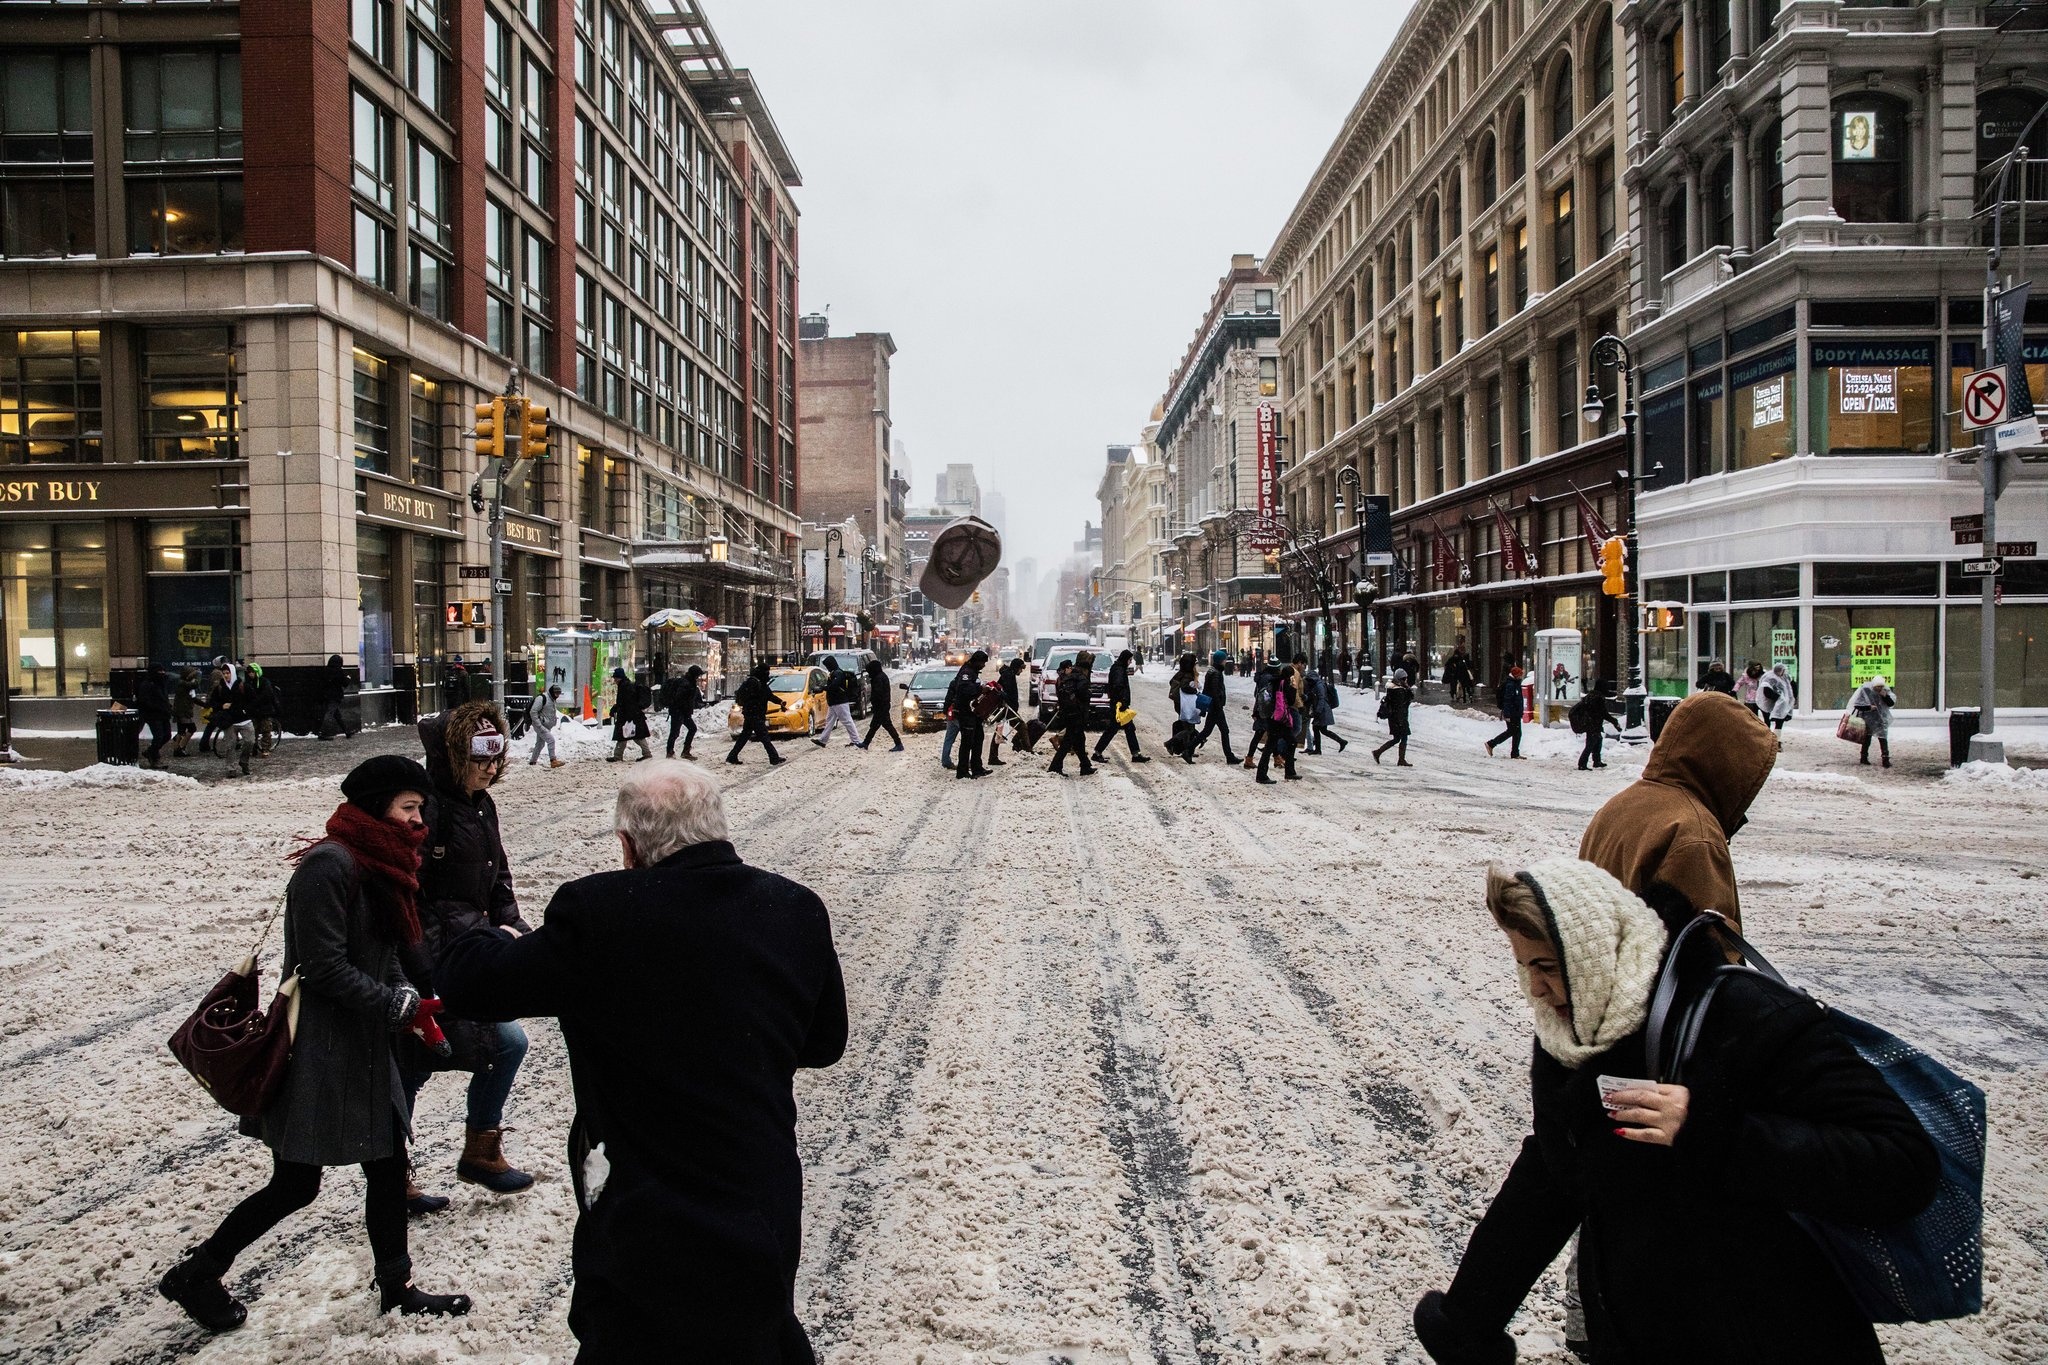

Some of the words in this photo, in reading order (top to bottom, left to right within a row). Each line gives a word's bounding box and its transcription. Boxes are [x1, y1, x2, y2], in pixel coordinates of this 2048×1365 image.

[1815, 348, 1856, 361] BODY
[1861, 348, 1929, 361] MASSAGE
[1845, 373, 1872, 384] CHELSEA
[1873, 373, 1892, 384] NAILS
[1845, 384, 1892, 394] 212-924-6245
[1843, 397, 1865, 410] OPEN
[1866, 393, 1874, 412] 7
[1874, 397, 1895, 410] DAYS
[1260, 407, 1273, 528] Burlington
[48, 481, 101, 501] BUY
[383, 492, 411, 515] BEST
[414, 499, 436, 520] BUY
[506, 521, 525, 540] BEST
[527, 527, 542, 543] BUY
[1962, 534, 1966, 543] 6
[1968, 533, 1977, 543] Av
[2000, 546, 2008, 555] W
[2011, 546, 2021, 555] 23
[2024, 546, 2033, 555] St
[1967, 563, 1979, 572] ONE
[1984, 562, 1997, 571] WAY
[461, 569, 468, 577] W
[470, 569, 477, 577] 23
[480, 569, 486, 577] St
[182, 628, 211, 636] BEST
[1774, 633, 1793, 641] STORE
[1856, 631, 1890, 640] STORE
[183, 635, 207, 644] BUY
[1855, 645, 1892, 656] RENT
